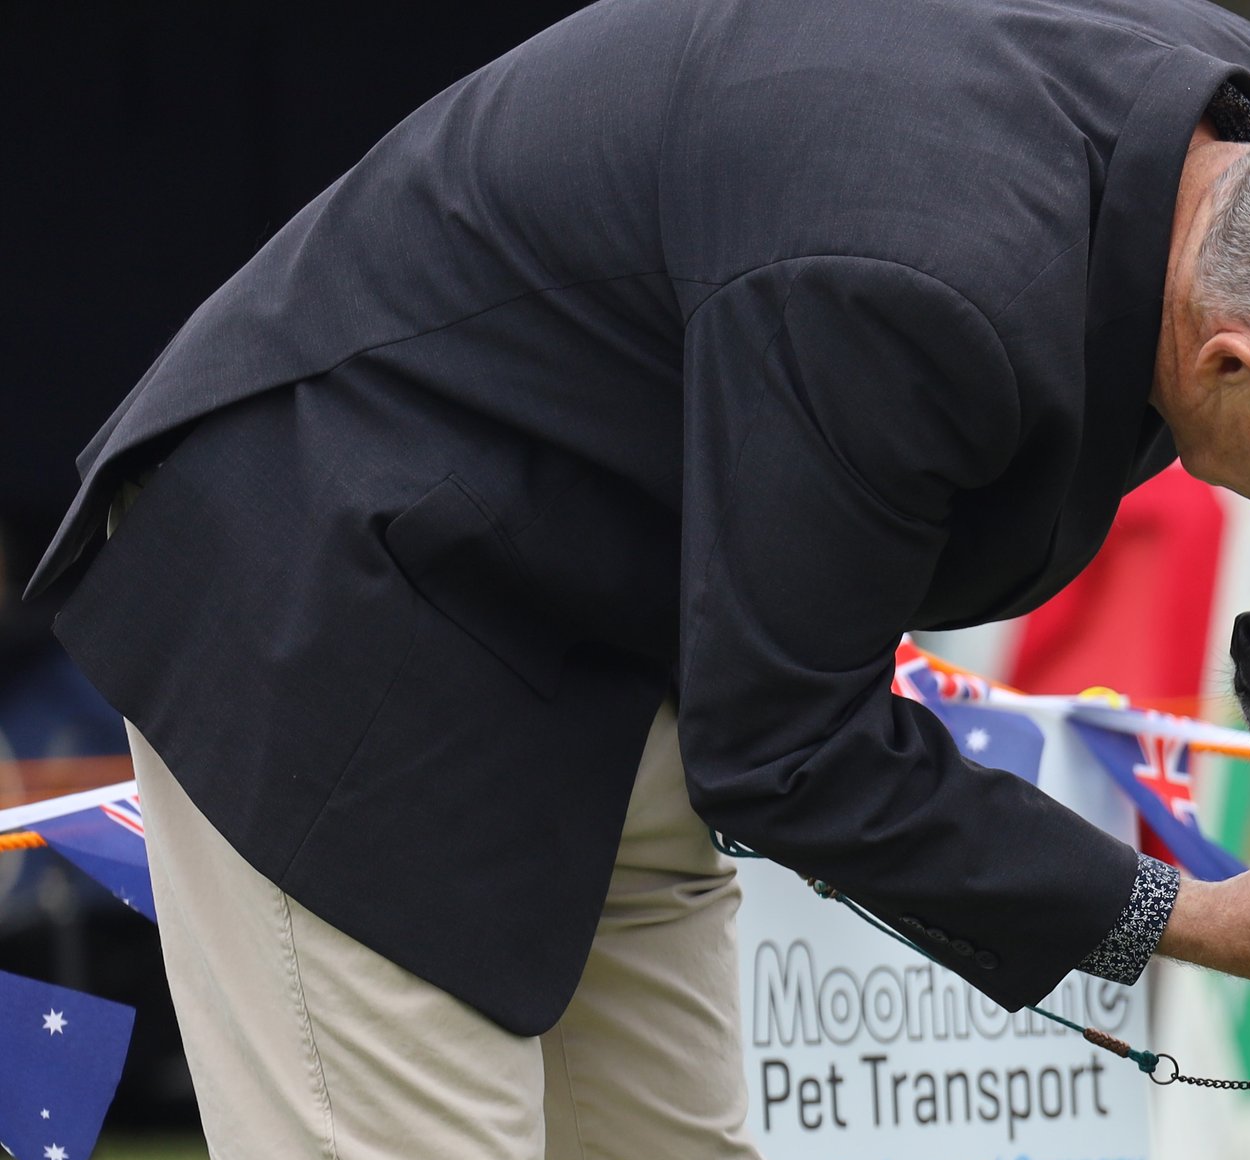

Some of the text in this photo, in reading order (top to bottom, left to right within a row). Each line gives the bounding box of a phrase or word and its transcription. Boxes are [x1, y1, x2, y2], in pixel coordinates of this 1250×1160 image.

[752, 936, 1131, 1047] Moorhome
[761, 1053, 1109, 1142] Pet Transport
